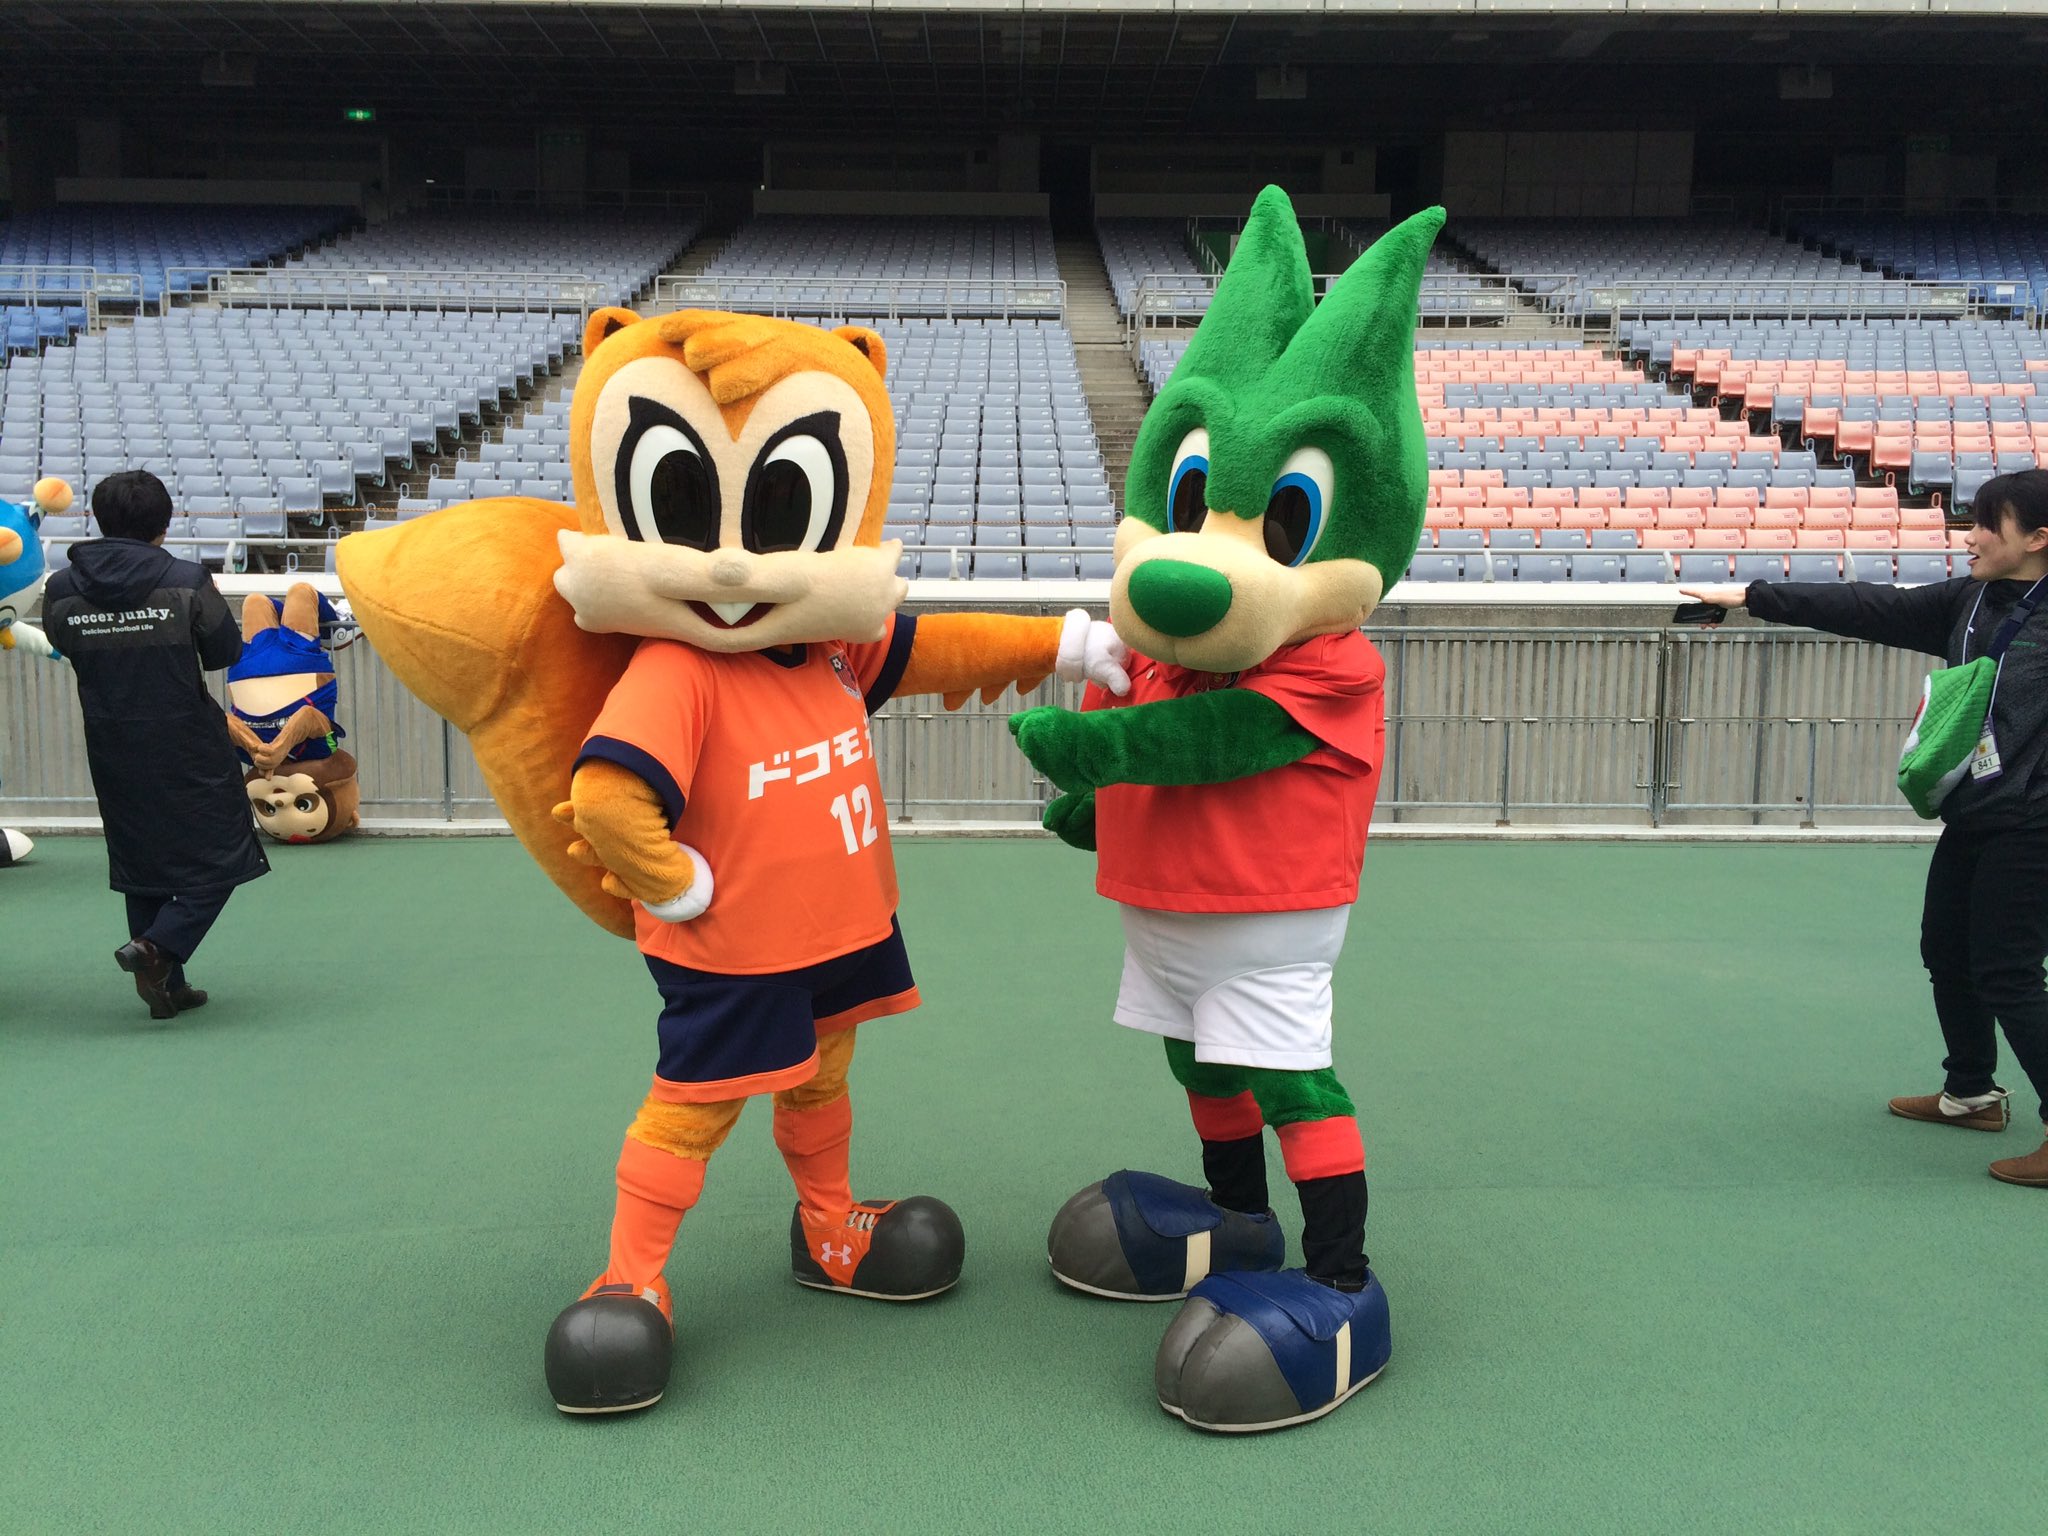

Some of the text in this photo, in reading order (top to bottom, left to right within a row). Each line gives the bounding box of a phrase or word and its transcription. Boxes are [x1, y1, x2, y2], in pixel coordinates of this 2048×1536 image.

[67, 612, 115, 626] soccer
[112, 625, 140, 633] Football
[1978, 758, 1993, 770] 841
[830, 784, 879, 855] 12
